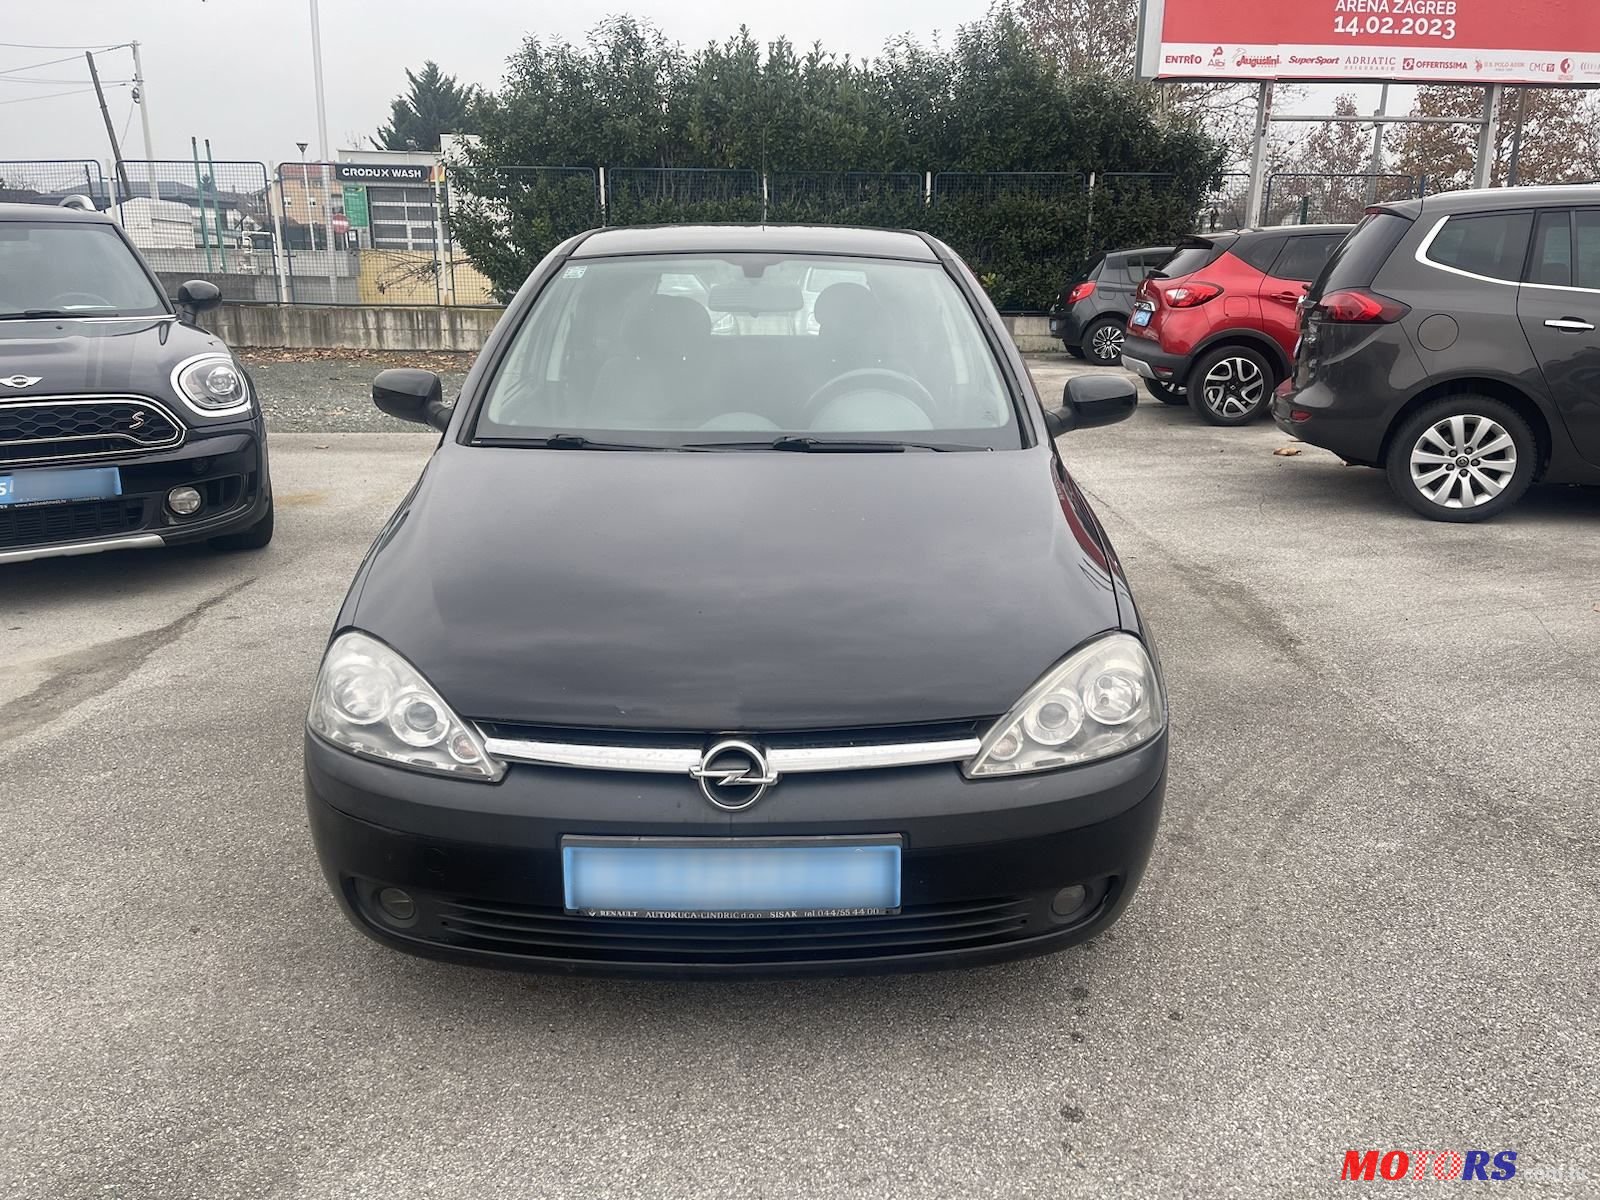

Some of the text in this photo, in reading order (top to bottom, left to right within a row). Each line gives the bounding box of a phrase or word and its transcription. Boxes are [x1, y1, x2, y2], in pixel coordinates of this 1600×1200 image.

[1335, 0, 1457, 15] ARENA ZAGREB
[1333, 15, 1457, 40] 14.02.2023
[1288, 55, 1340, 66] SuperSport
[1344, 56, 1397, 66] ADRIATIC
[1416, 61, 1468, 70] OFFERTISSIMA
[342, 167, 421, 178] CRODUX WASH
[600, 910, 639, 918] RENAULT
[770, 910, 798, 919] SISAK
